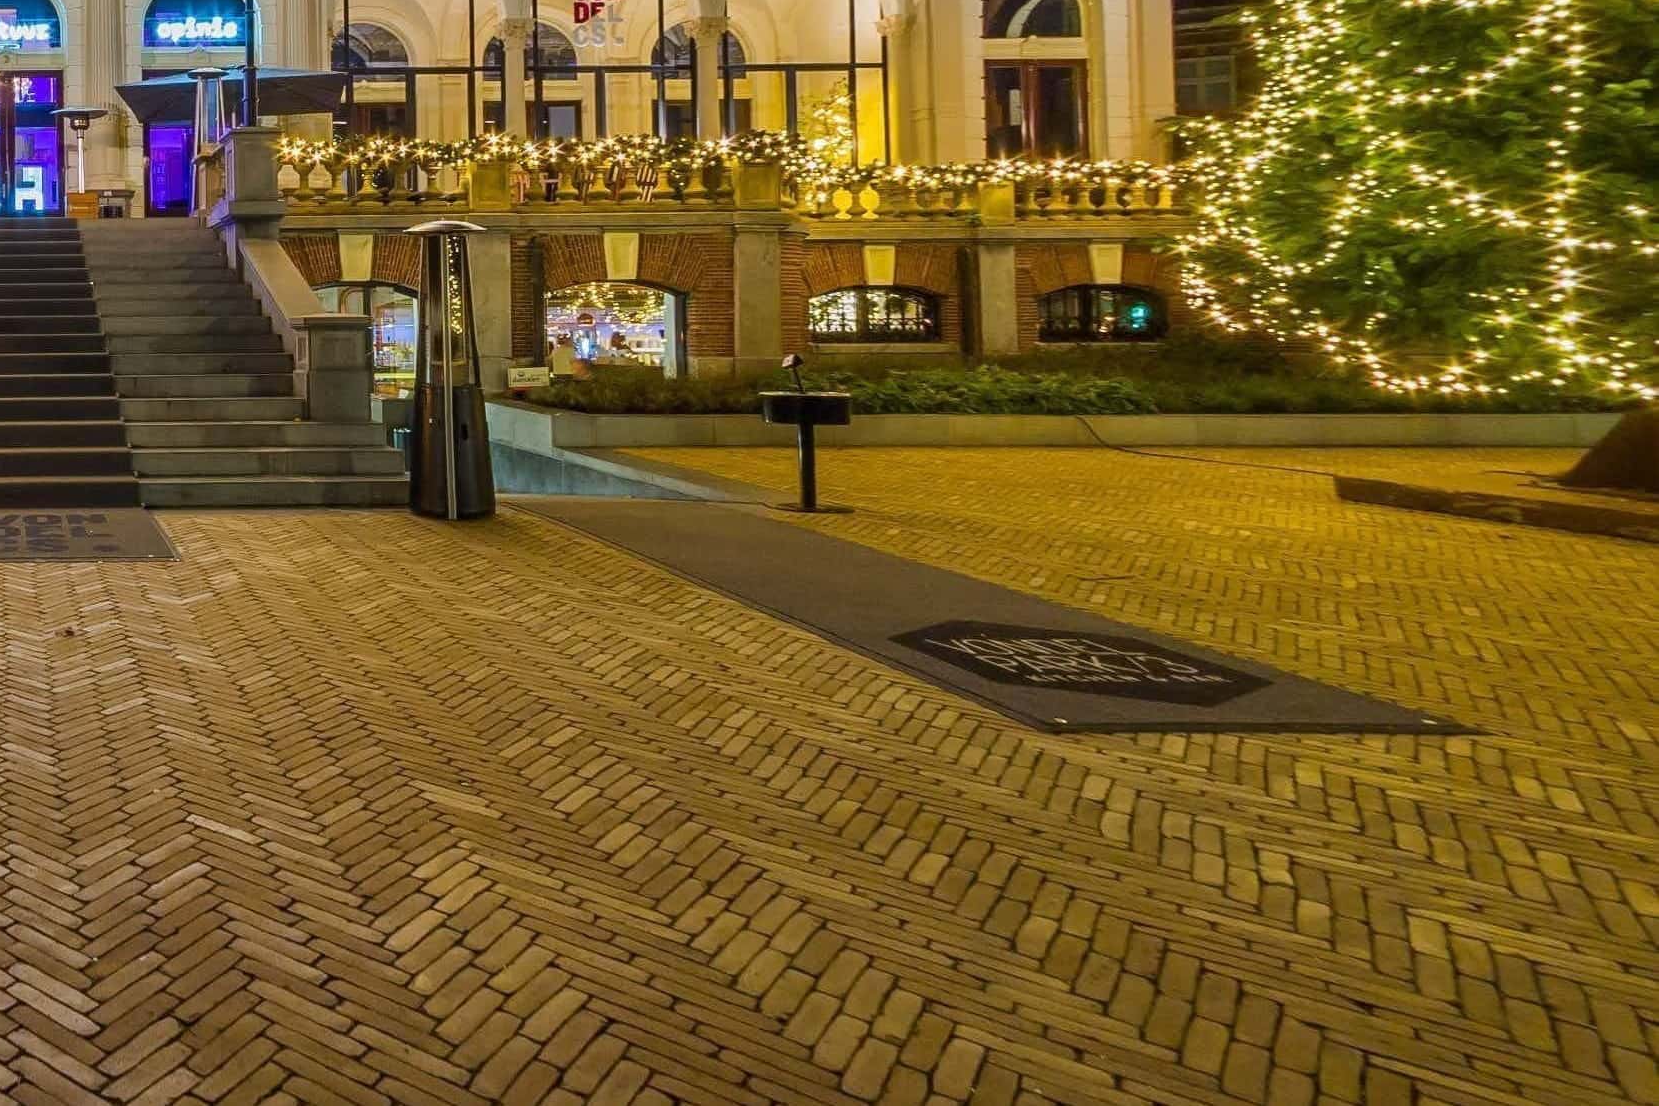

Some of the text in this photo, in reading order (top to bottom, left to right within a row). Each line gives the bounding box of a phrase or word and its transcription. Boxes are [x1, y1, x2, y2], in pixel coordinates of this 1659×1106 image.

[573, 1, 623, 24] DEL
[157, 15, 238, 45] opinie
[924, 638, 1145, 656] VONDEL
